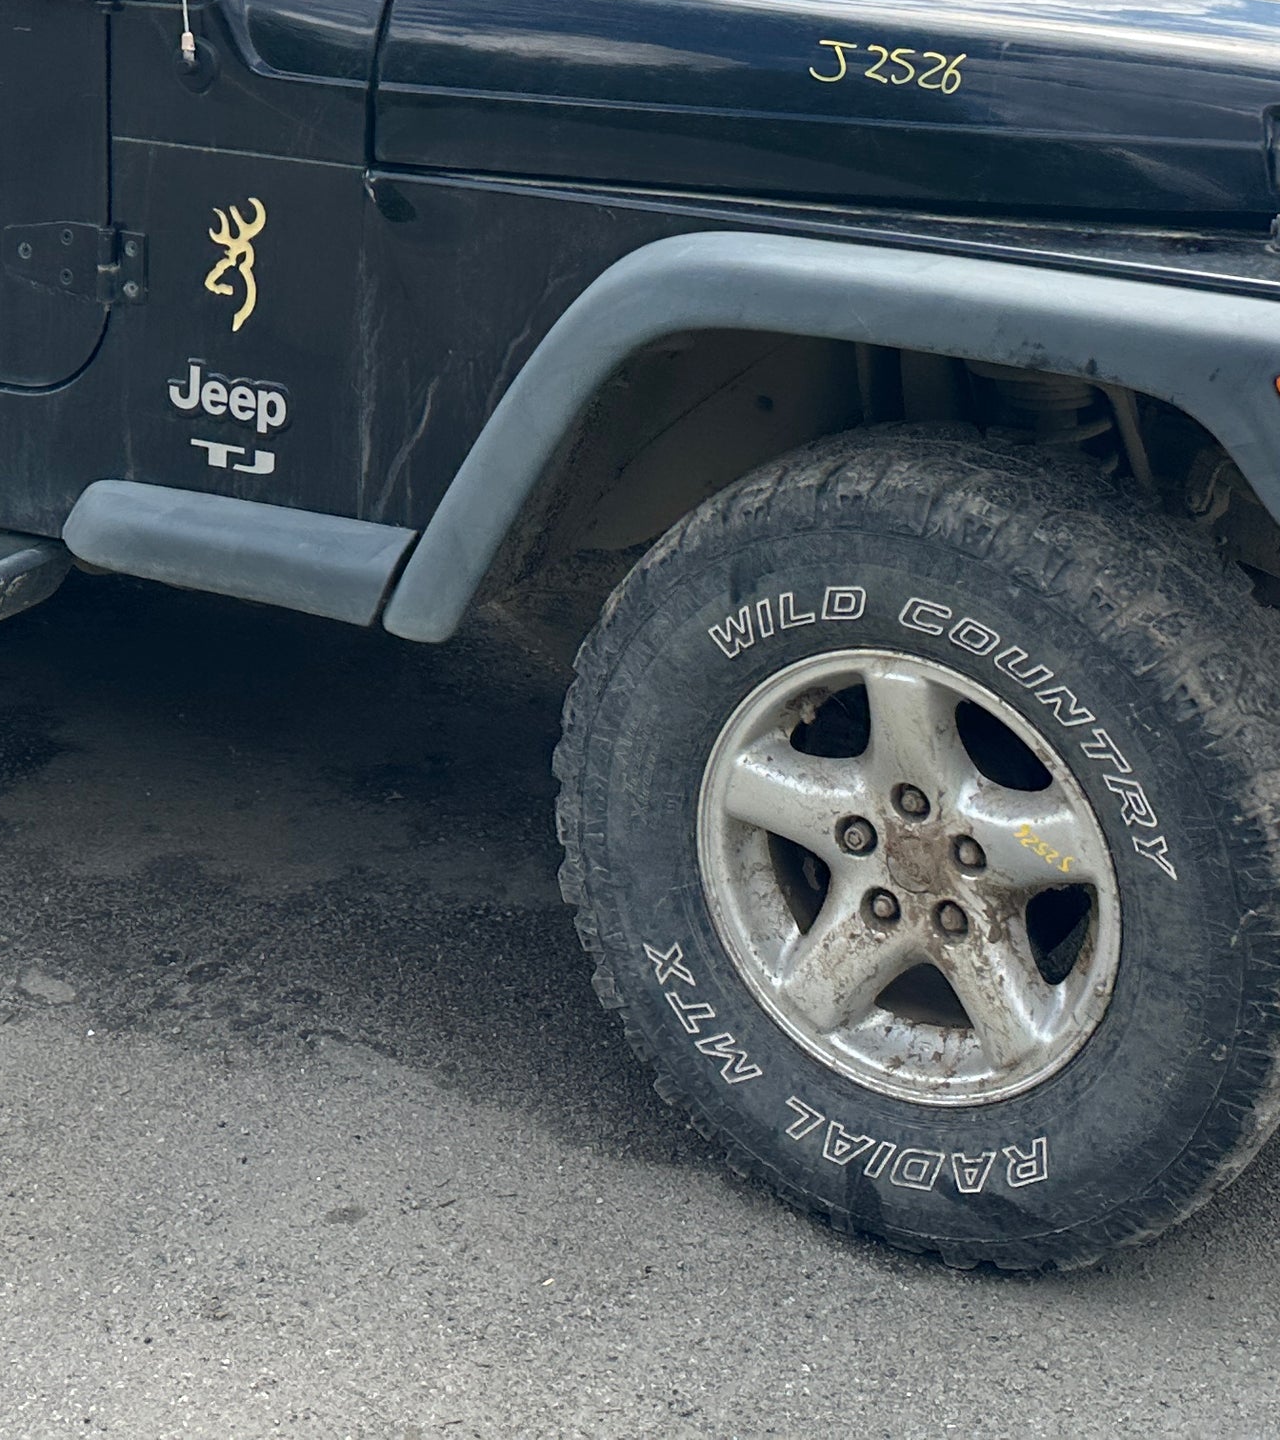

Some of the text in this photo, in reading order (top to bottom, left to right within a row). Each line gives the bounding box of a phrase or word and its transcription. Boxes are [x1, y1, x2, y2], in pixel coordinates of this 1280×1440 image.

[808, 39, 967, 95] J2526
[168, 358, 289, 434] Jeep
[190, 438, 276, 475] TJ
[708, 585, 1179, 882] WILD COUNTRY
[642, 940, 1049, 1195] RADIAL MTX
